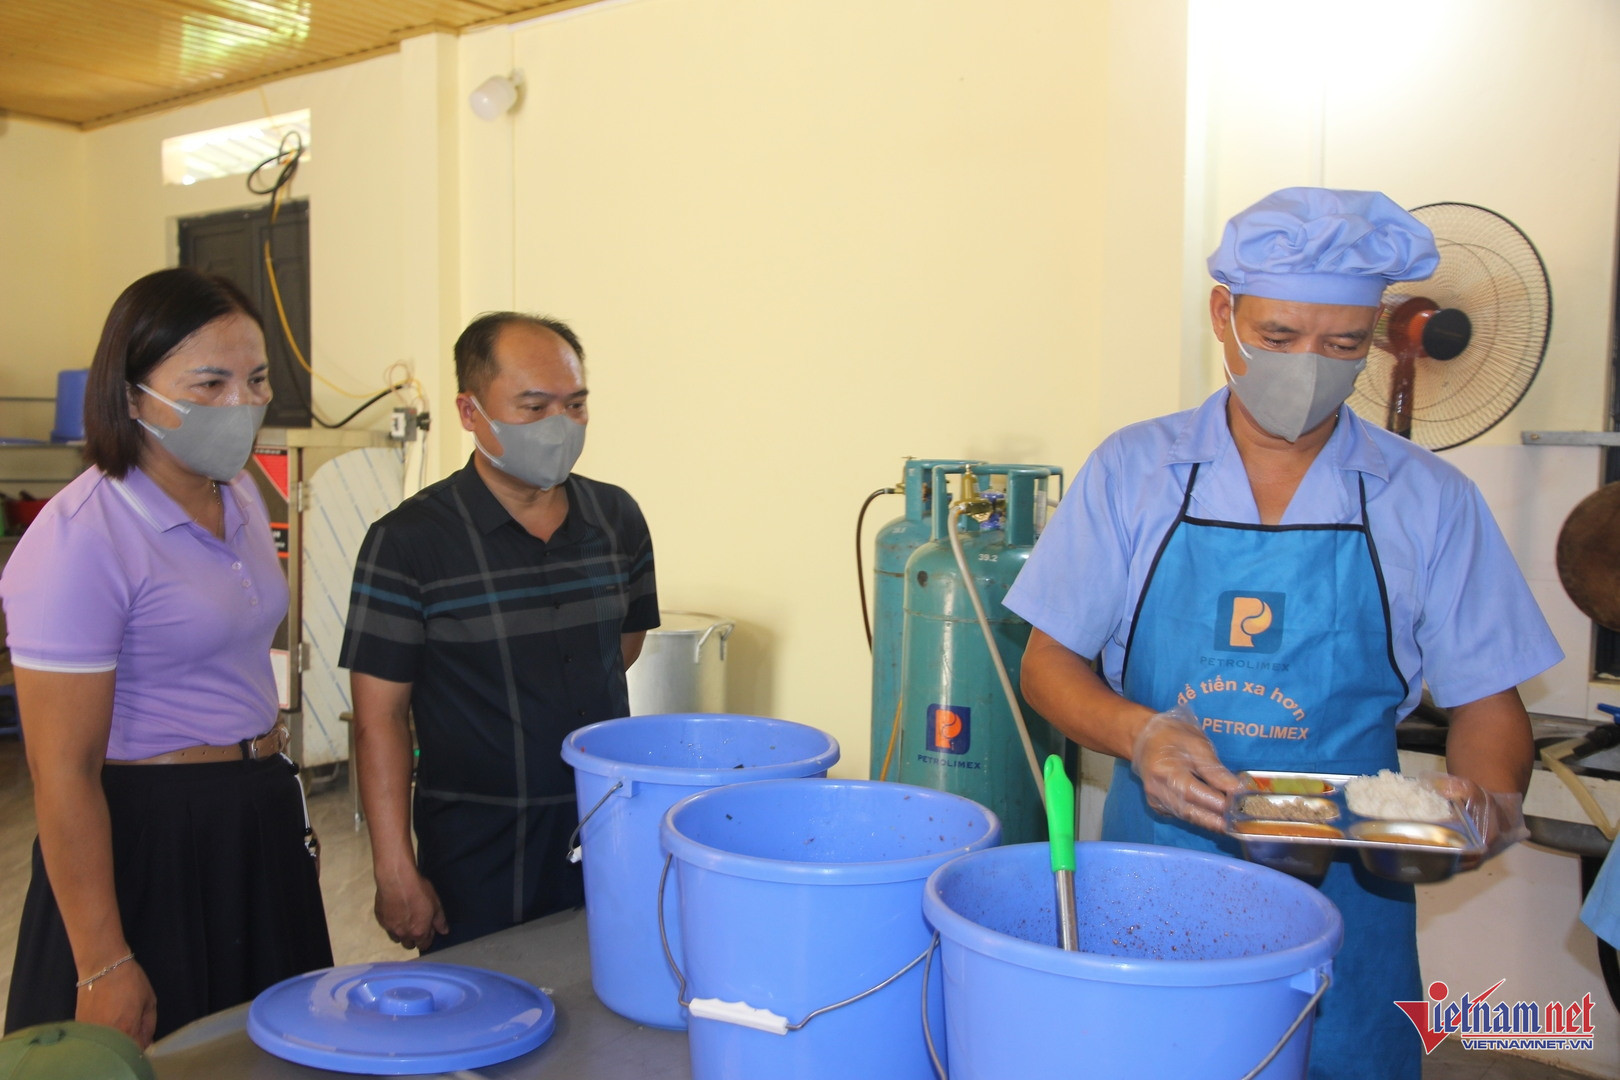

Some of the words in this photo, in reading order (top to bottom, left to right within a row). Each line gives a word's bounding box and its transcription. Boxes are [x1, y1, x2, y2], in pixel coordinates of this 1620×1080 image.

[977, 553, 999, 563] 39.2
[1200, 656, 1290, 672] PETROLIMEX
[1242, 681, 1266, 696] xa
[1270, 687, 1305, 721] hơn
[1202, 718, 1309, 740] PETROLIMEX
[917, 754, 981, 769] PETROLIMEX
